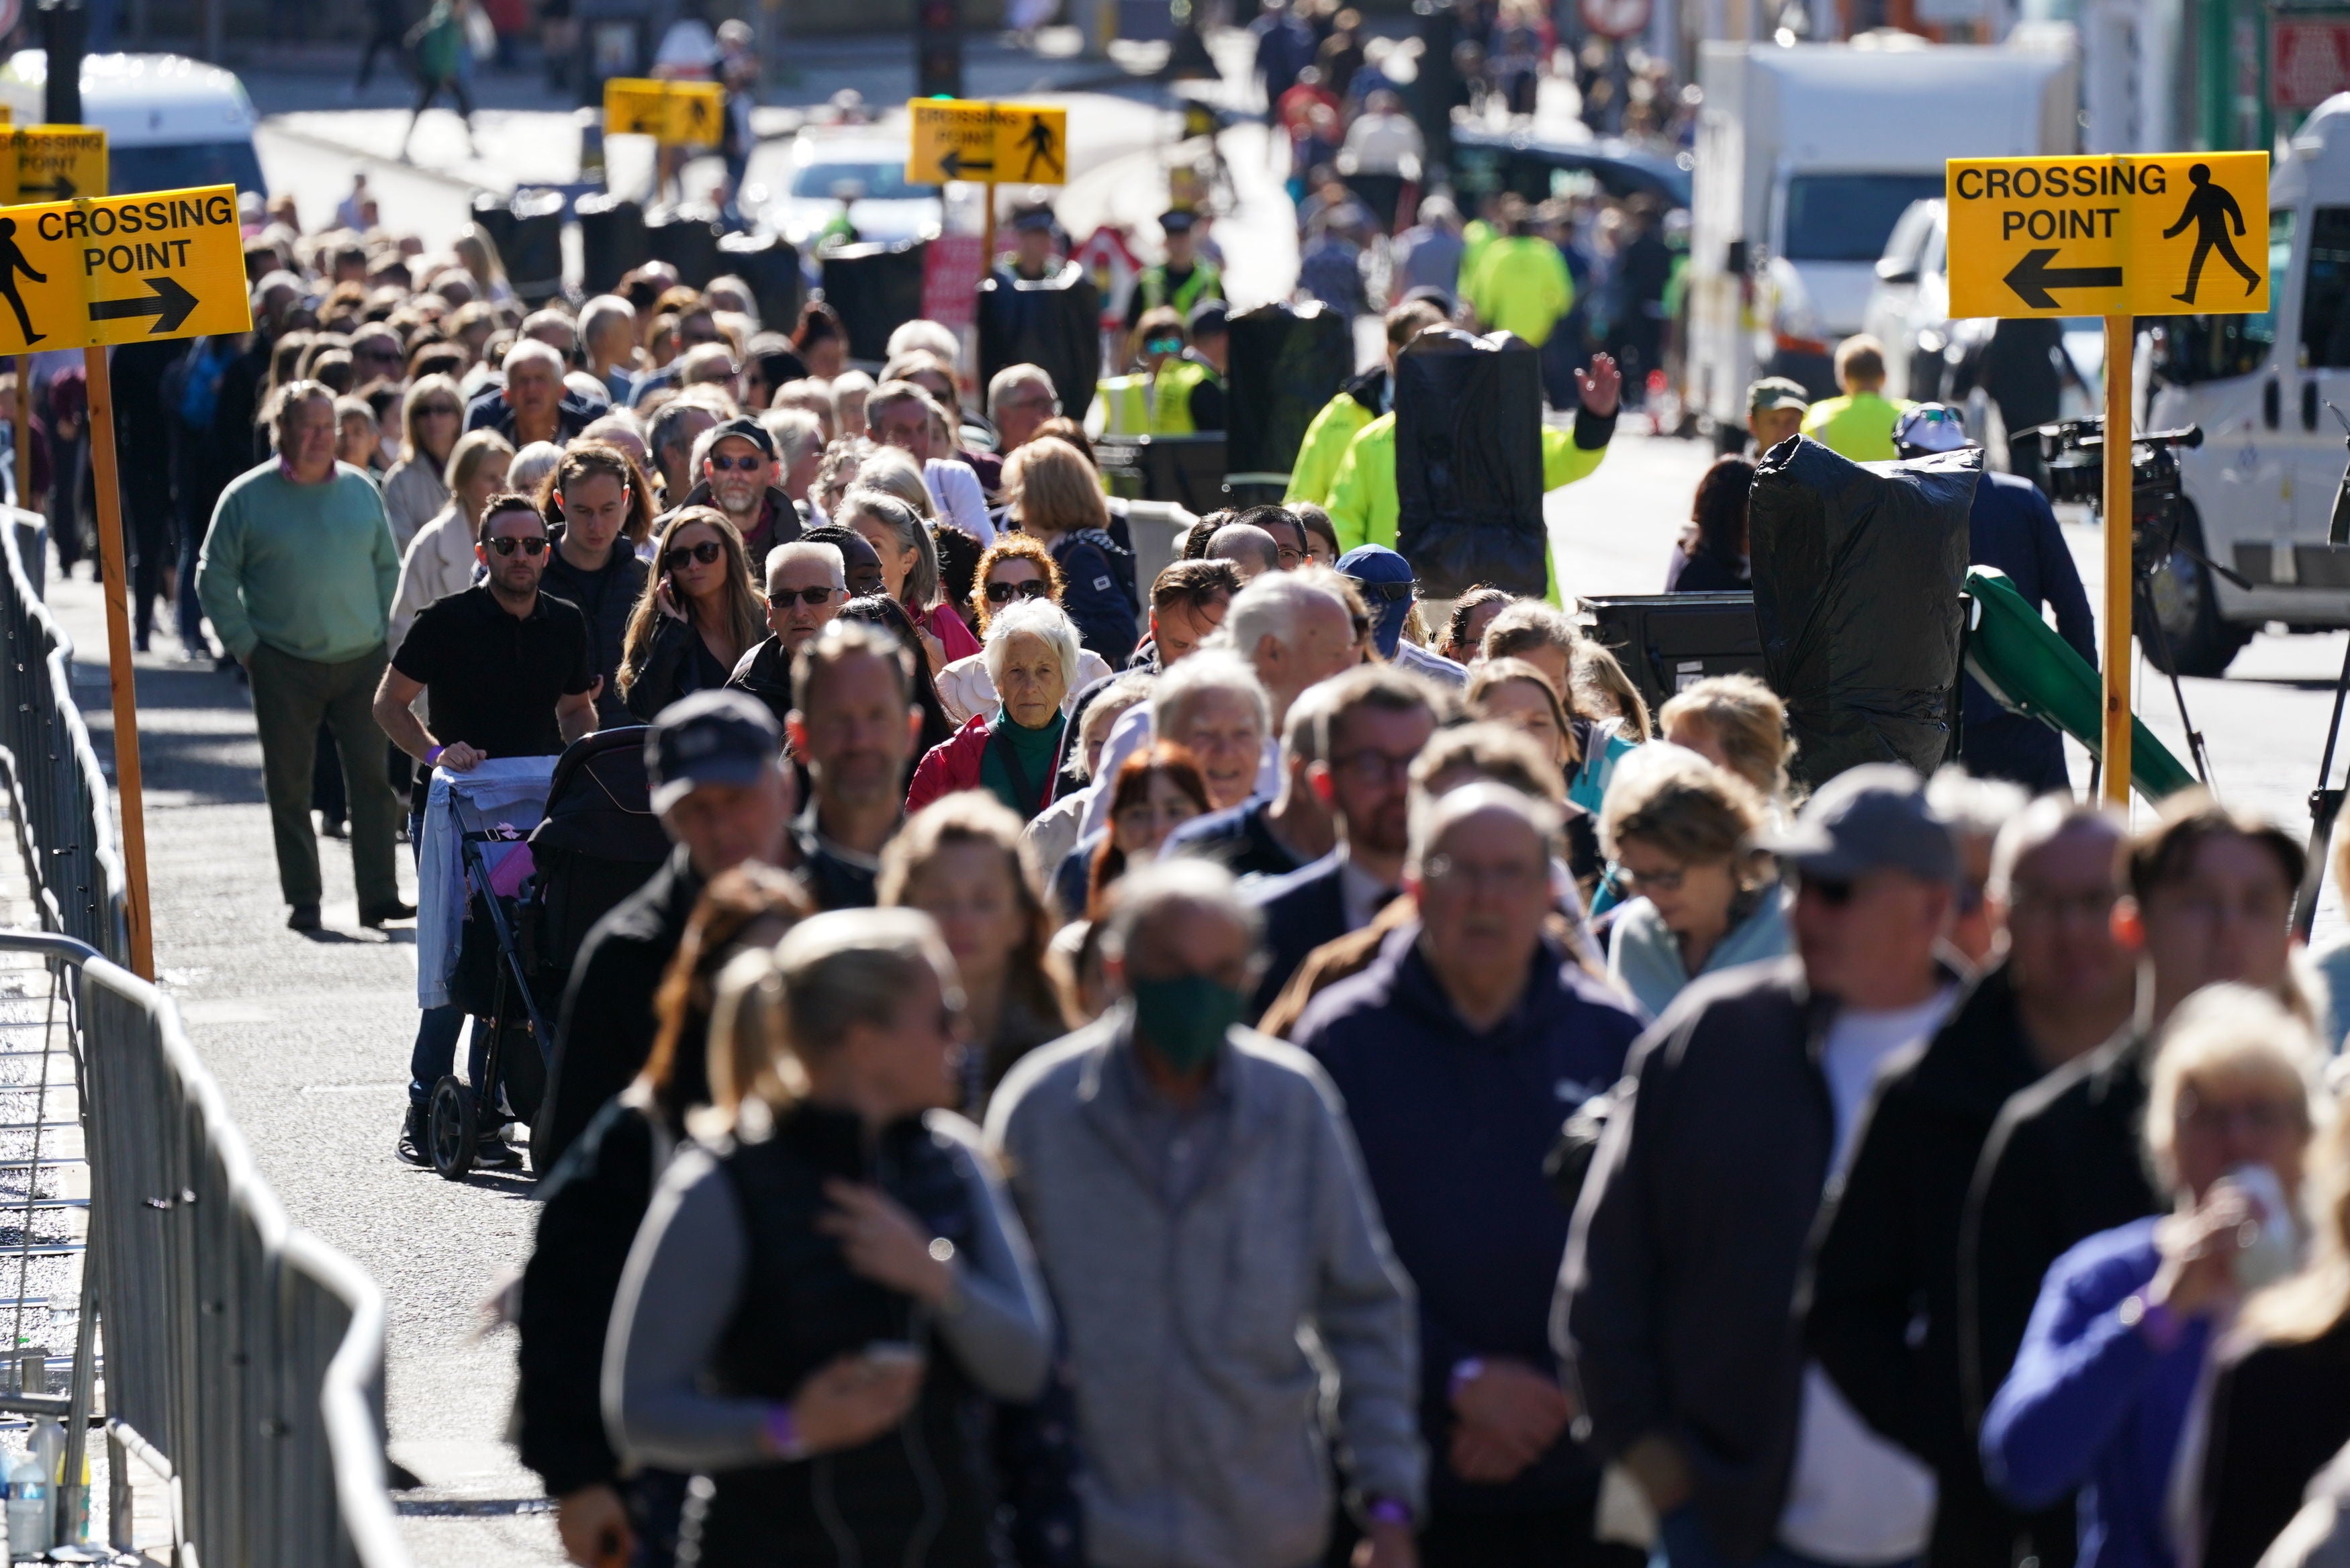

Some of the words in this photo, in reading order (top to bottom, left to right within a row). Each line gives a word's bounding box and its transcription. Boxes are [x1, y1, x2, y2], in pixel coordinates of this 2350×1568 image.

[1956, 164, 2166, 200] CROSSING
[38, 196, 232, 241] CROSSING
[2002, 208, 2120, 241] POINT
[83, 239, 191, 276] POINT
